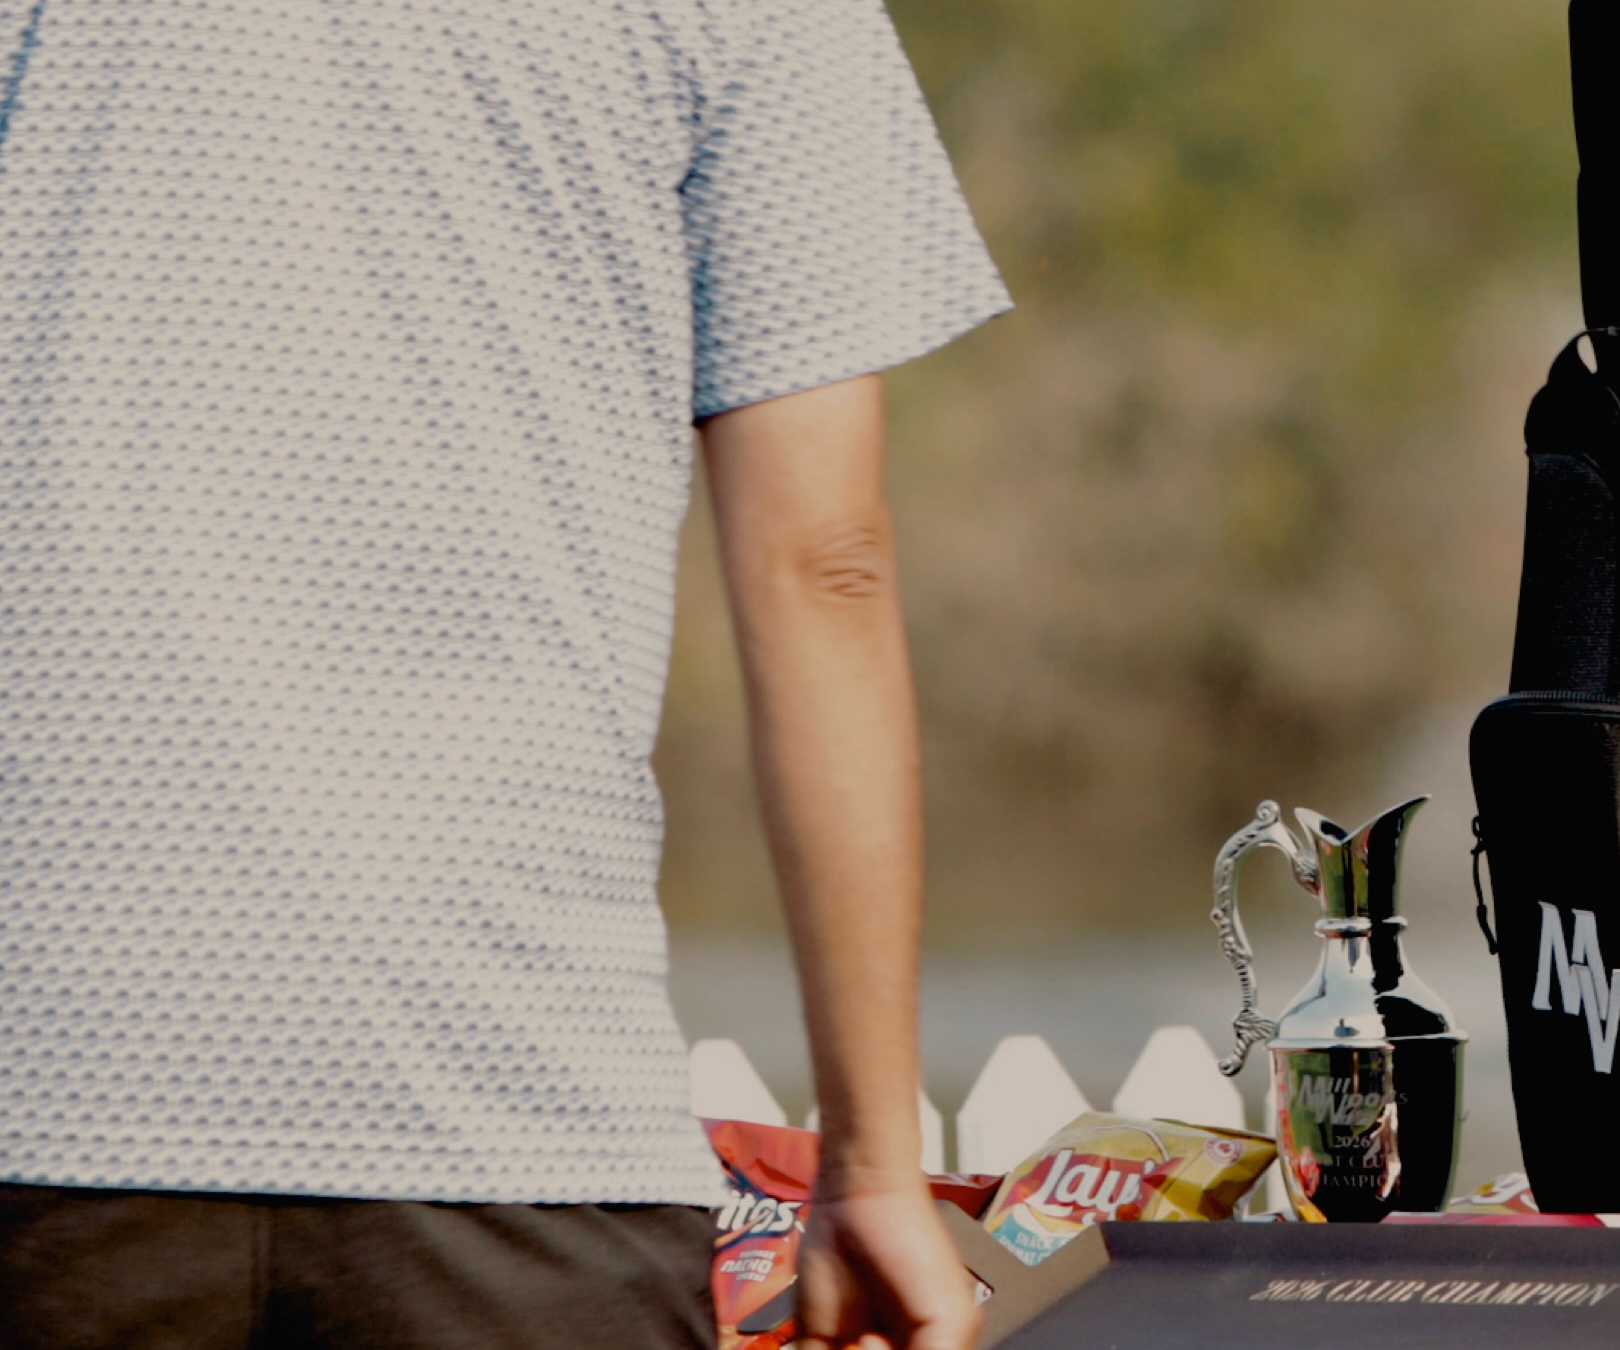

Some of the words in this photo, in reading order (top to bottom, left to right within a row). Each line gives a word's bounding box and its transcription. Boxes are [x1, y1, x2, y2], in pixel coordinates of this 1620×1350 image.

[1335, 1135, 1371, 1149] 2026
[1023, 1148, 1156, 1225] Lay'
[716, 1189, 803, 1234] itos
[1249, 1278, 1334, 1302] 2026
[1325, 1278, 1428, 1304] CLUB
